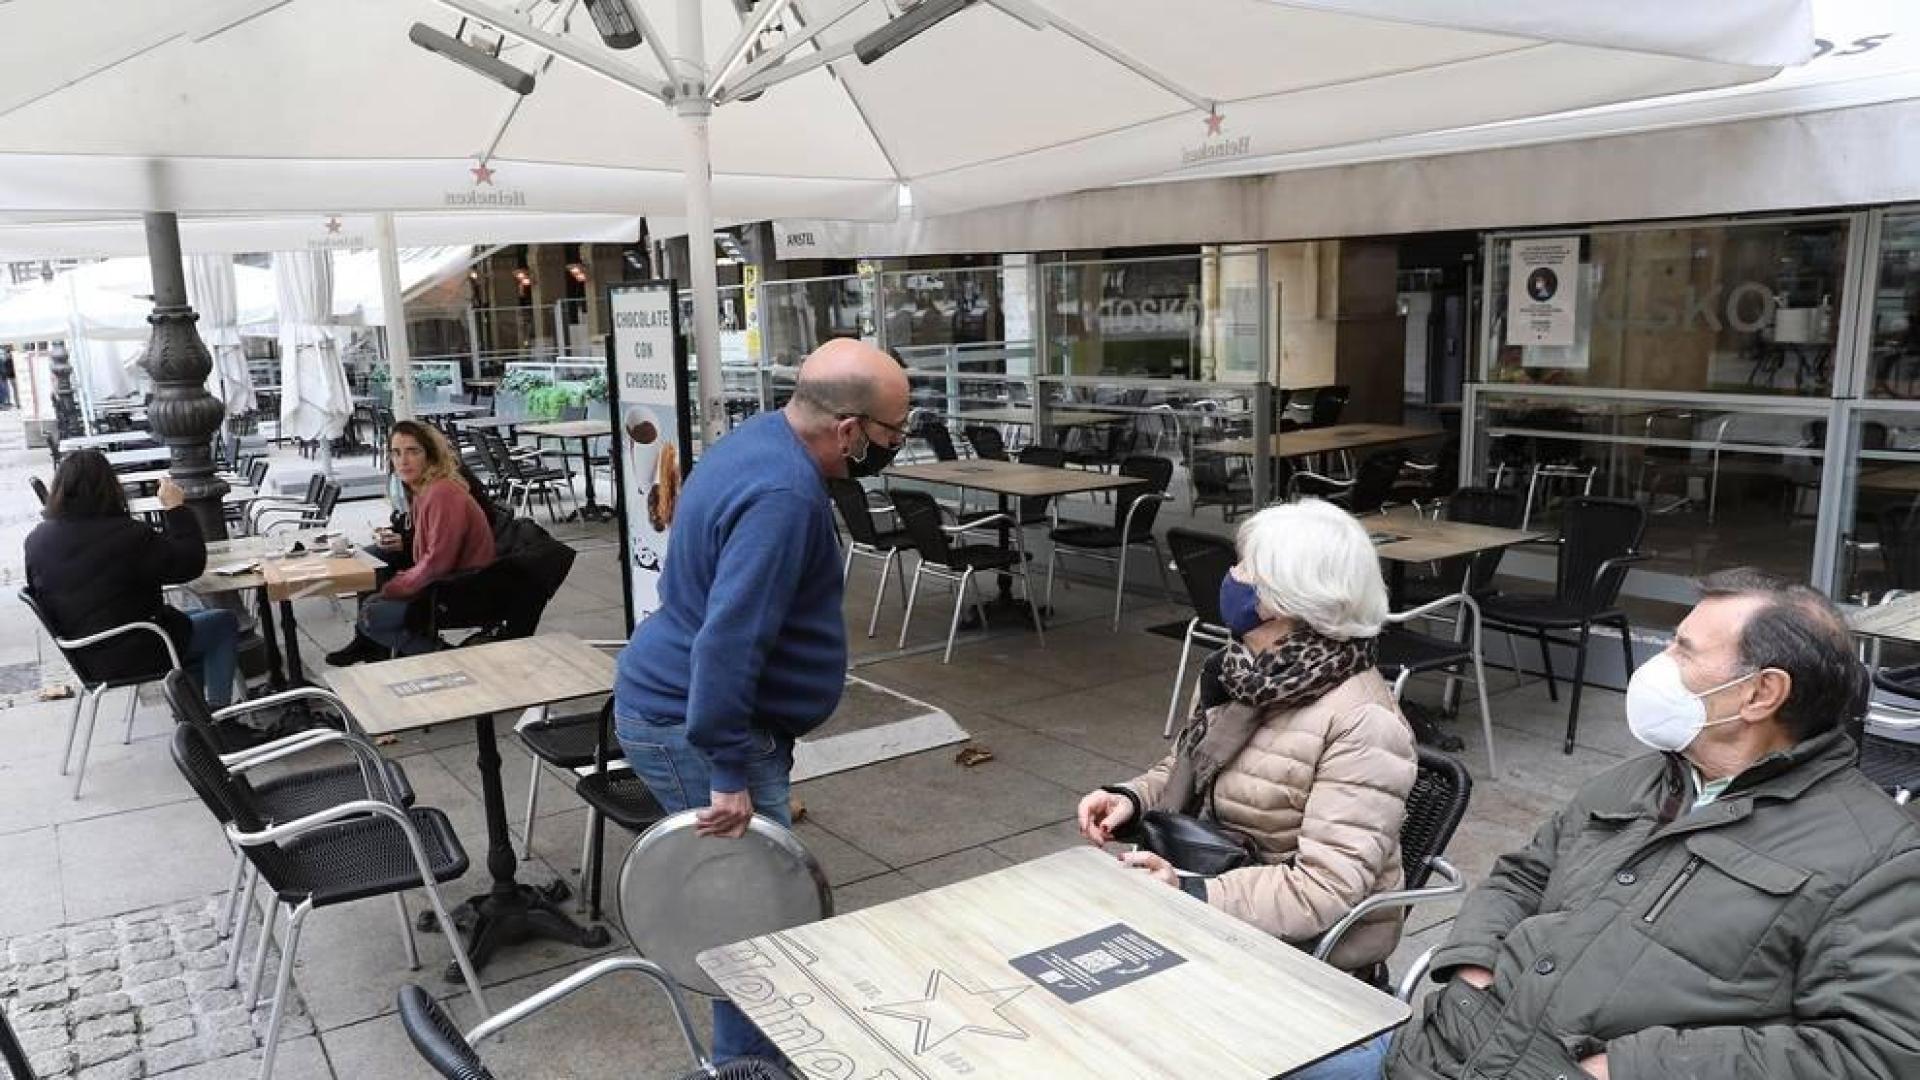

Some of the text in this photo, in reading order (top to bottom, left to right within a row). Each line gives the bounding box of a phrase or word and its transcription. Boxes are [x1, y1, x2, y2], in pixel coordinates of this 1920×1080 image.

[786, 231, 815, 247] AMSTEL
[616, 309, 668, 328] CHOCOLATE
[634, 341, 653, 359] CON
[626, 371, 667, 391] CHURROS
